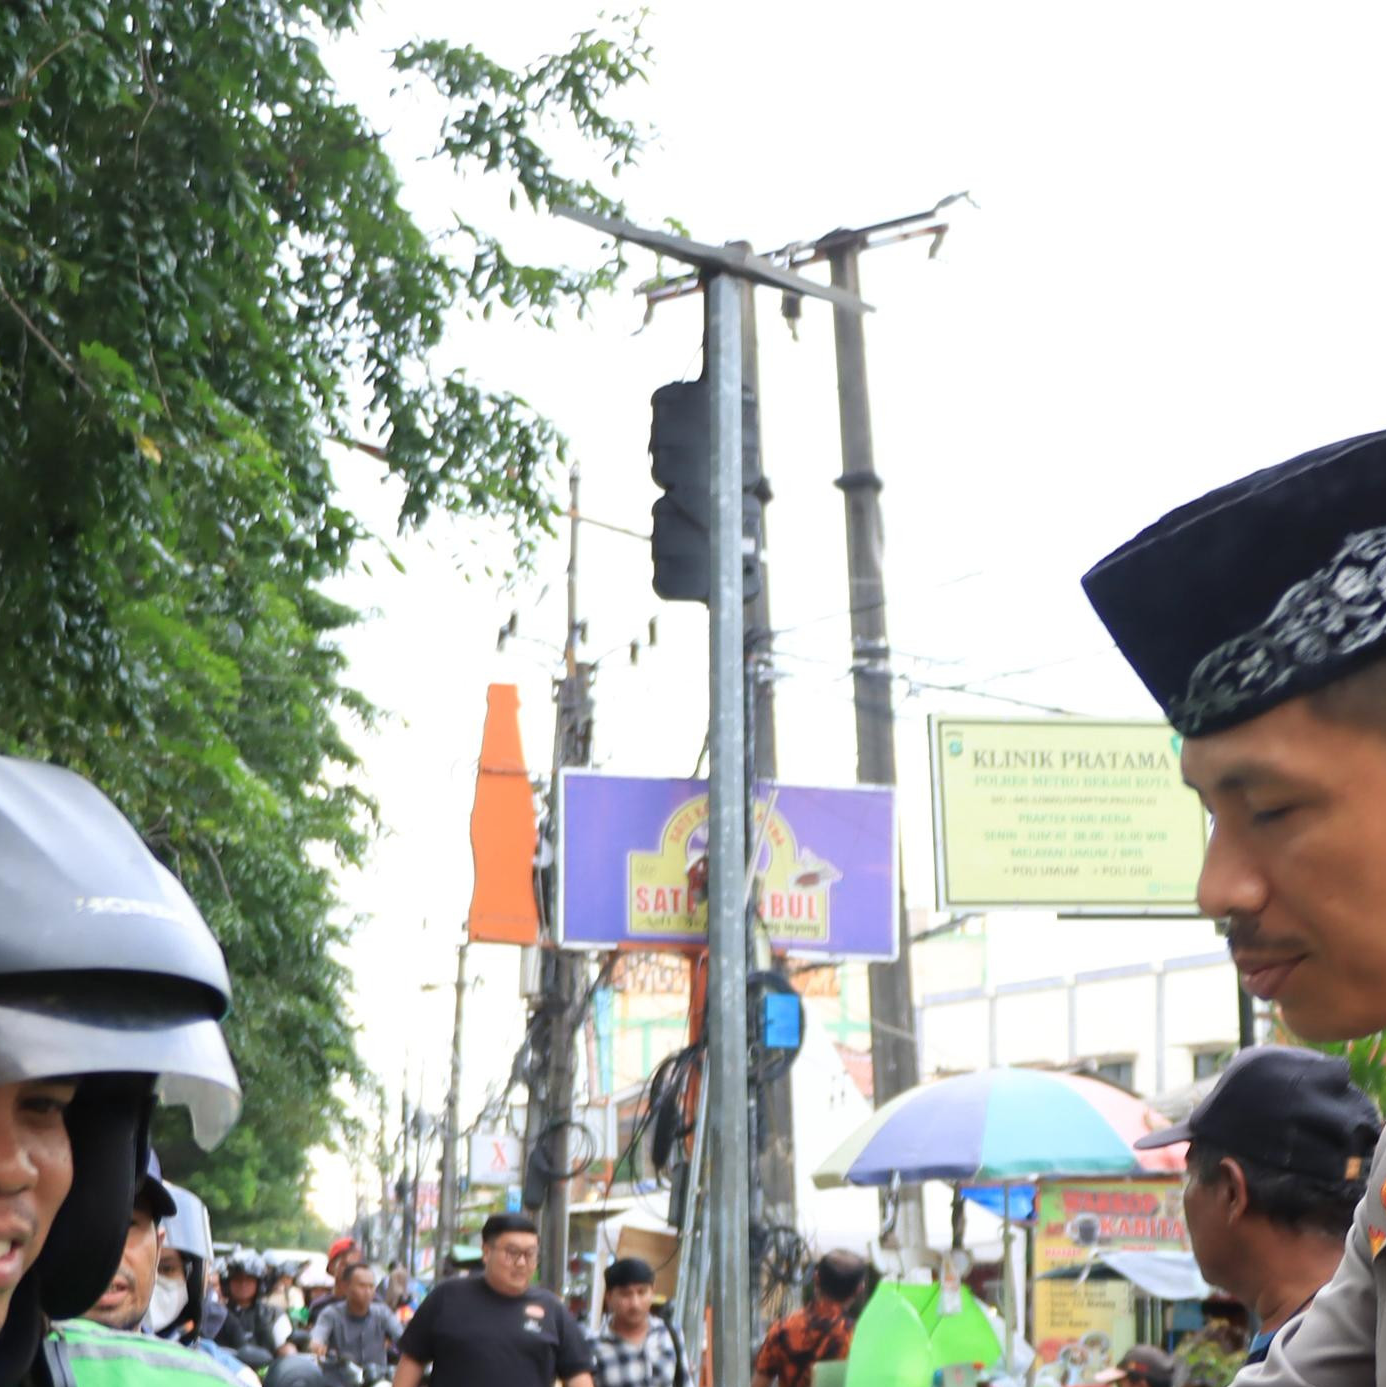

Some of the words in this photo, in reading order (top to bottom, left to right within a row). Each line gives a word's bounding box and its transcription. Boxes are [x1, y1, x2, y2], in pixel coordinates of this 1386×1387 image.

[973, 749, 1053, 769] KLINIK
[1062, 750, 1170, 770] PRATAMA
[1033, 775, 1079, 787] METRO
[1135, 776, 1171, 788] KOTA
[1040, 866, 1079, 876] UMUM
